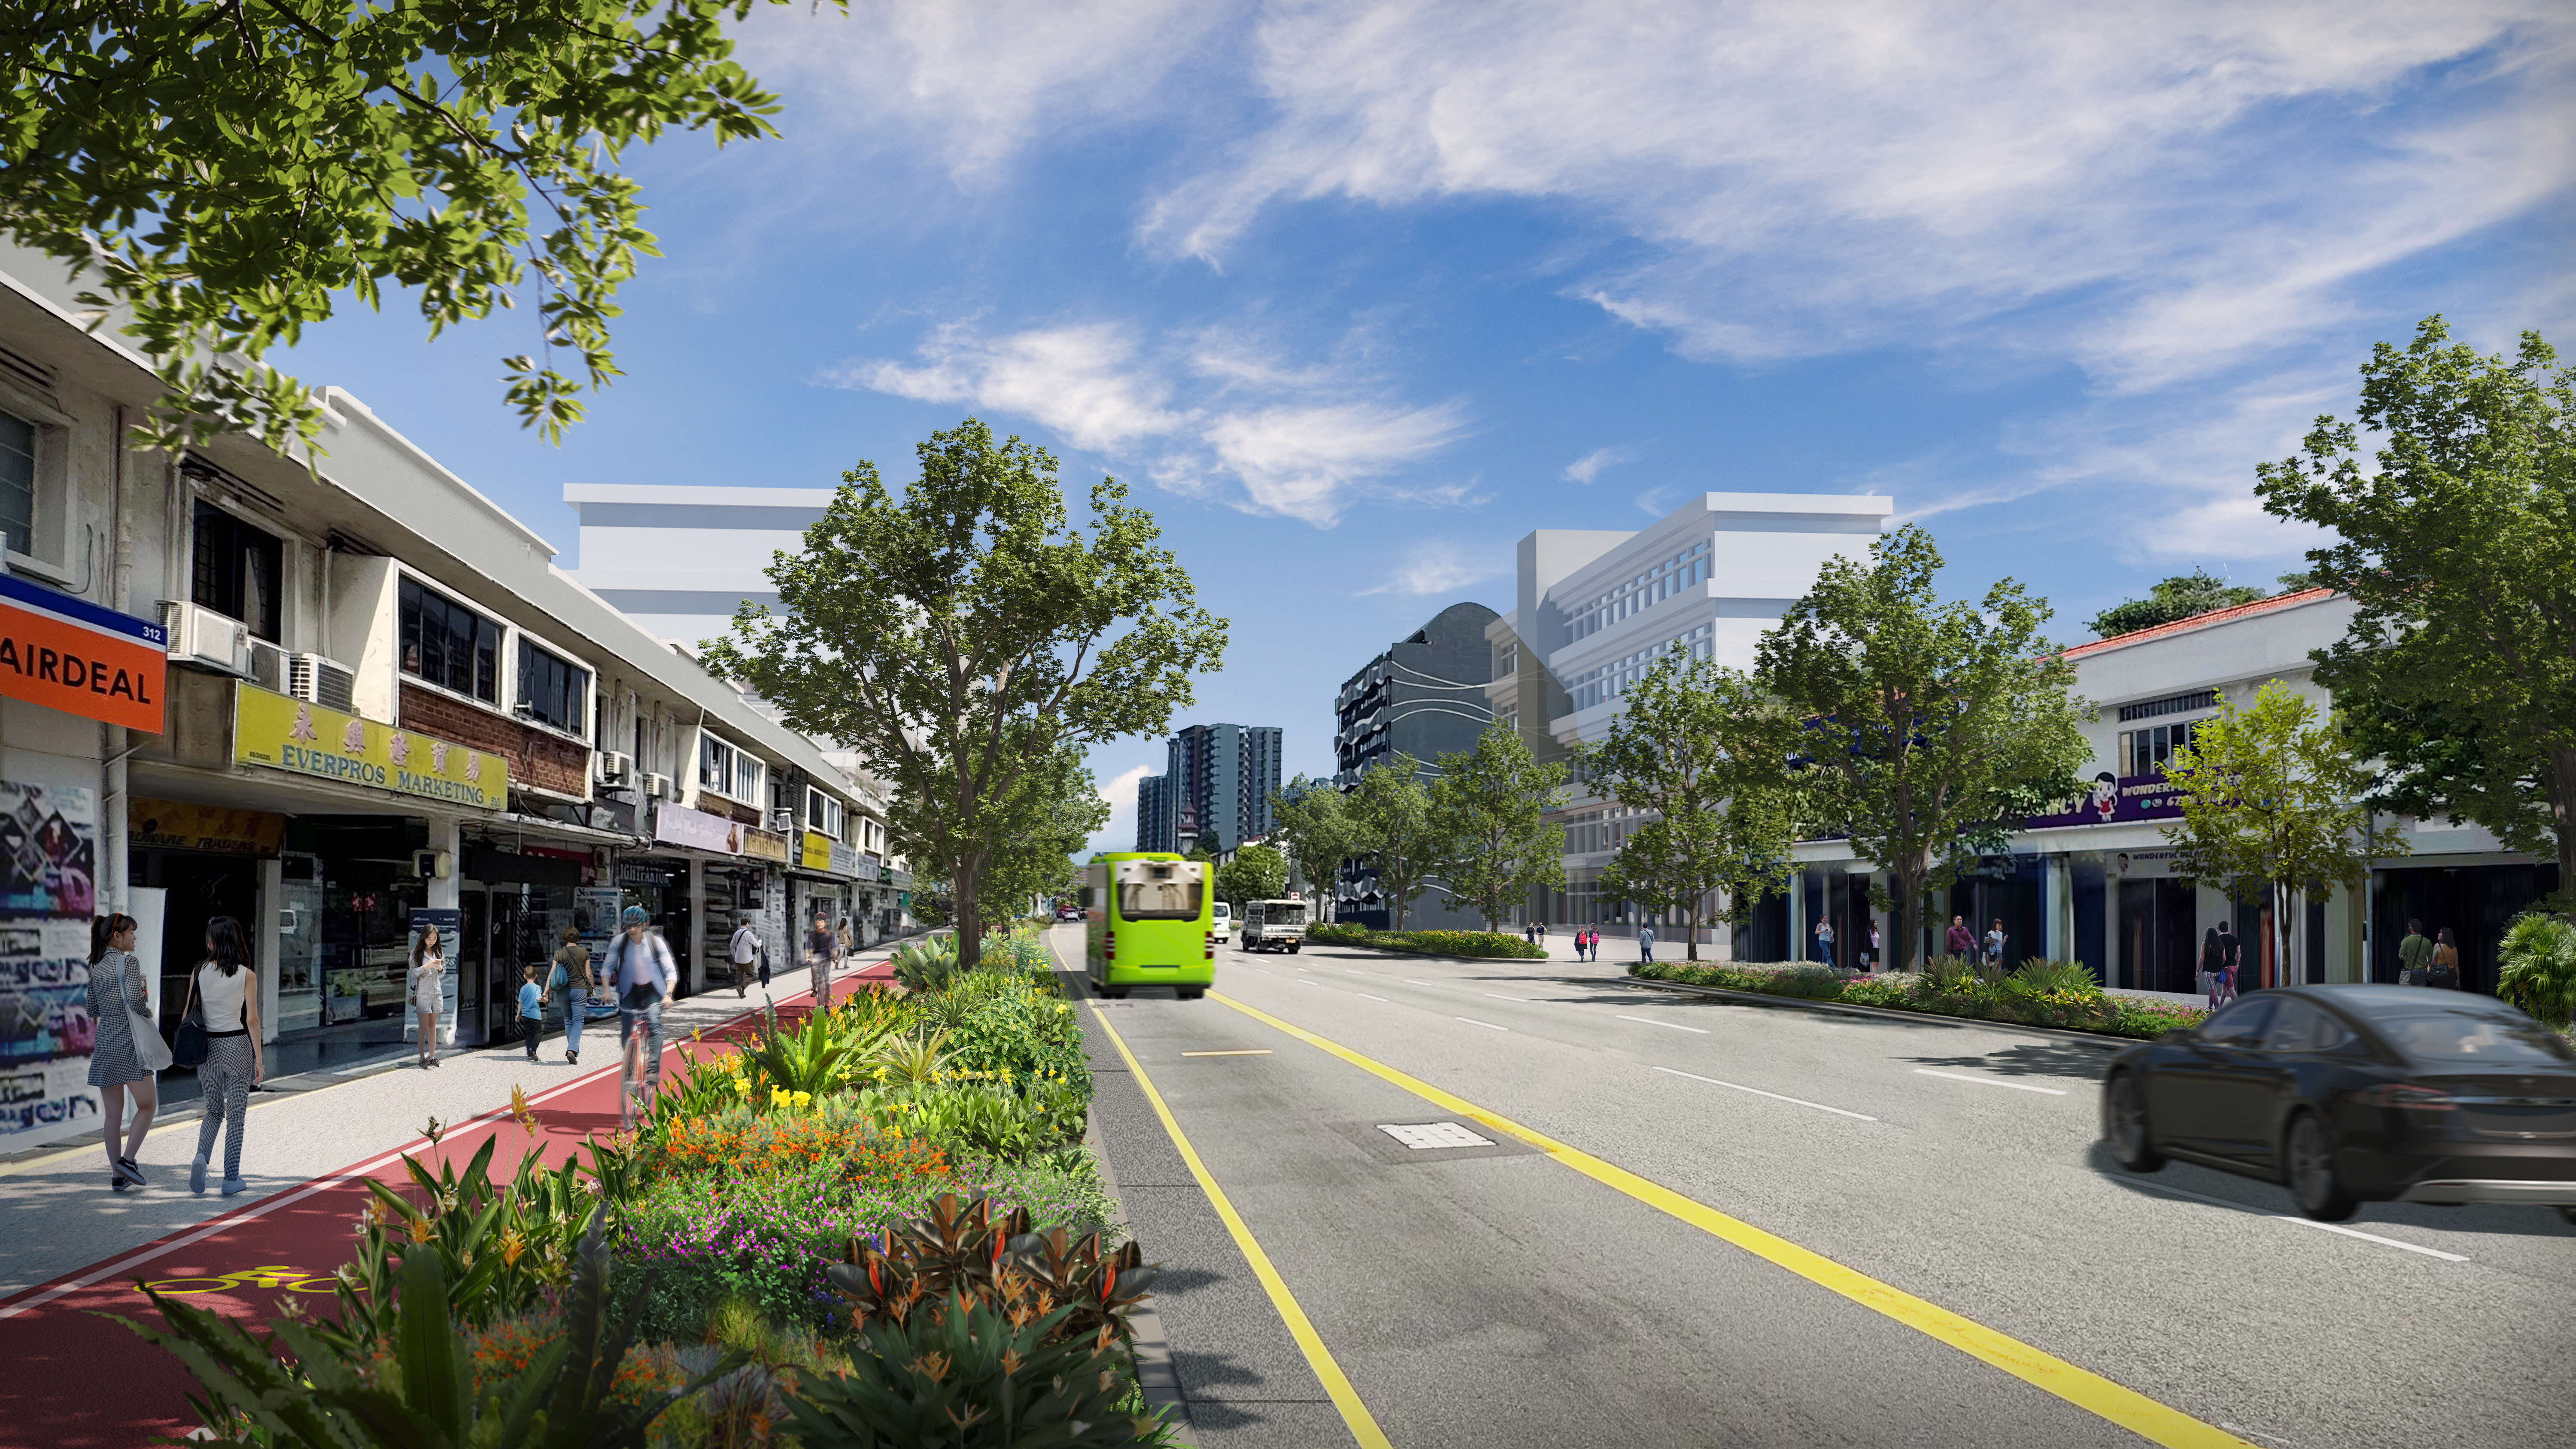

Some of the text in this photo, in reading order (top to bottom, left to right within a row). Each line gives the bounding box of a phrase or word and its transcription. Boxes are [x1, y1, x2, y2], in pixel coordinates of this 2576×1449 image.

[143, 626, 161, 641] 312
[282, 744, 484, 804] EVERPROS MARKETING
[2133, 852, 2177, 860] WONDERFUL
